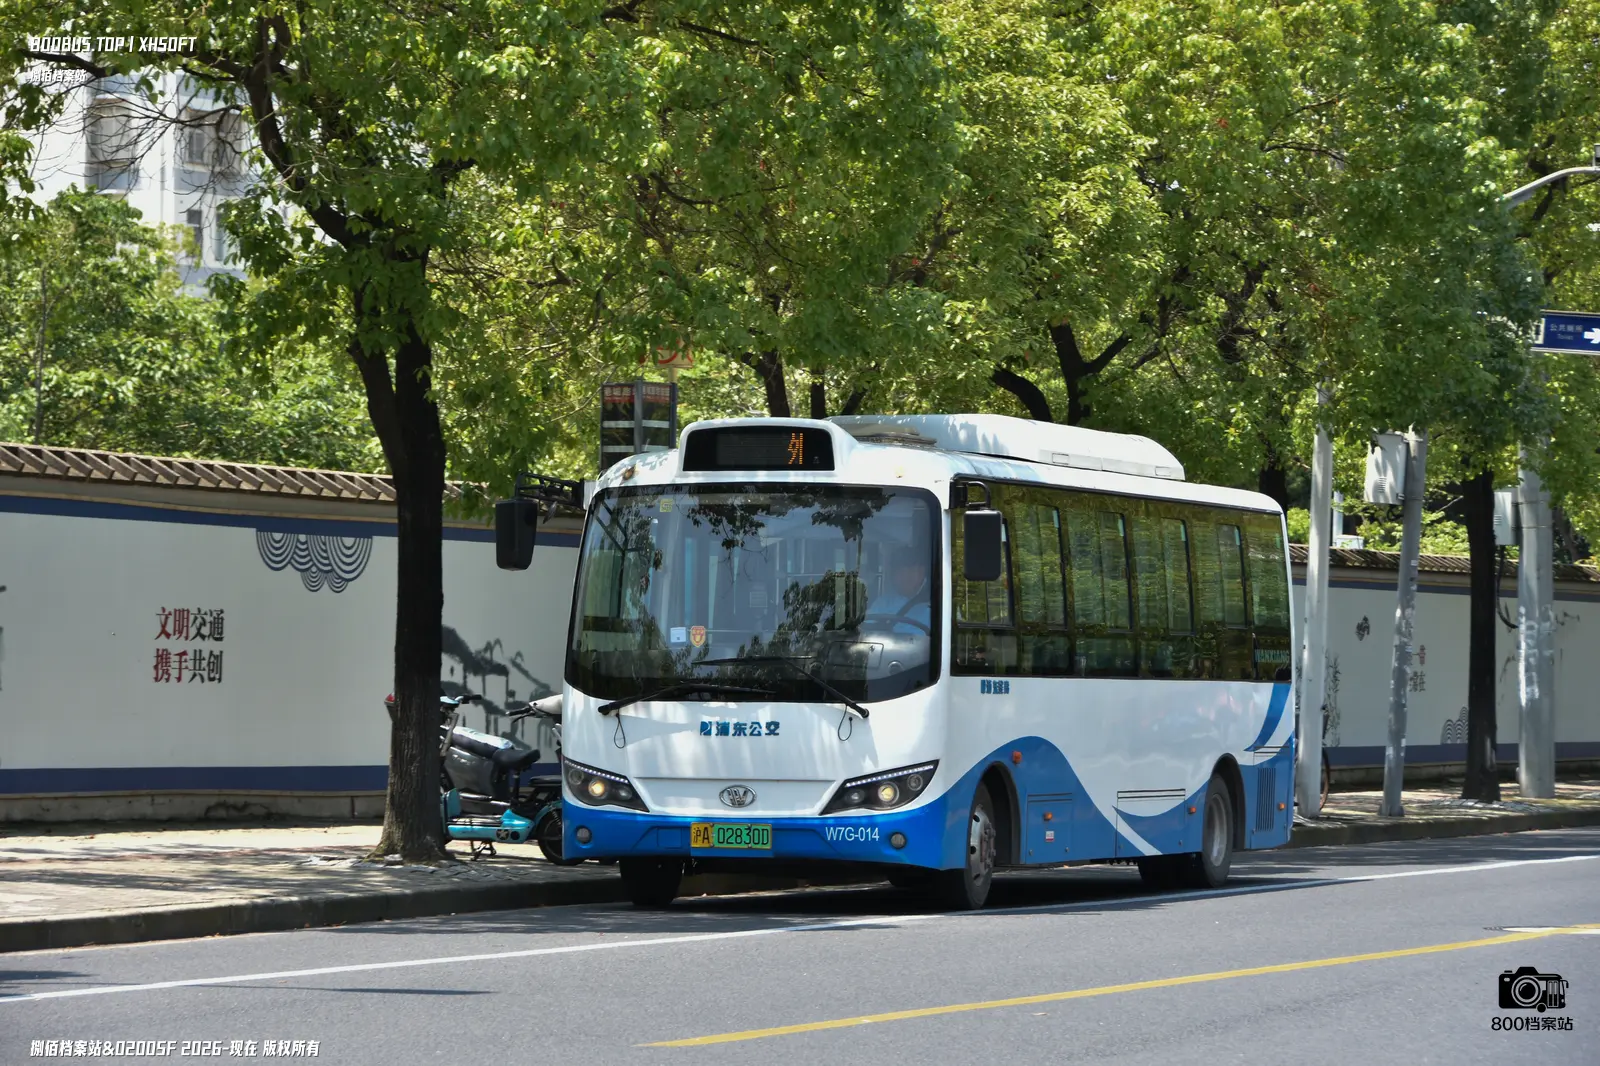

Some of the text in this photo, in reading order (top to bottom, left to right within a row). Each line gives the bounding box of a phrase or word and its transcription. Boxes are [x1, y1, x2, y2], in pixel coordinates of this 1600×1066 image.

[154, 606, 226, 642] 文明交通
[153, 647, 224, 684] 携手共创
[715, 721, 780, 737] 浦东公交
[825, 826, 880, 842] W7G-014
